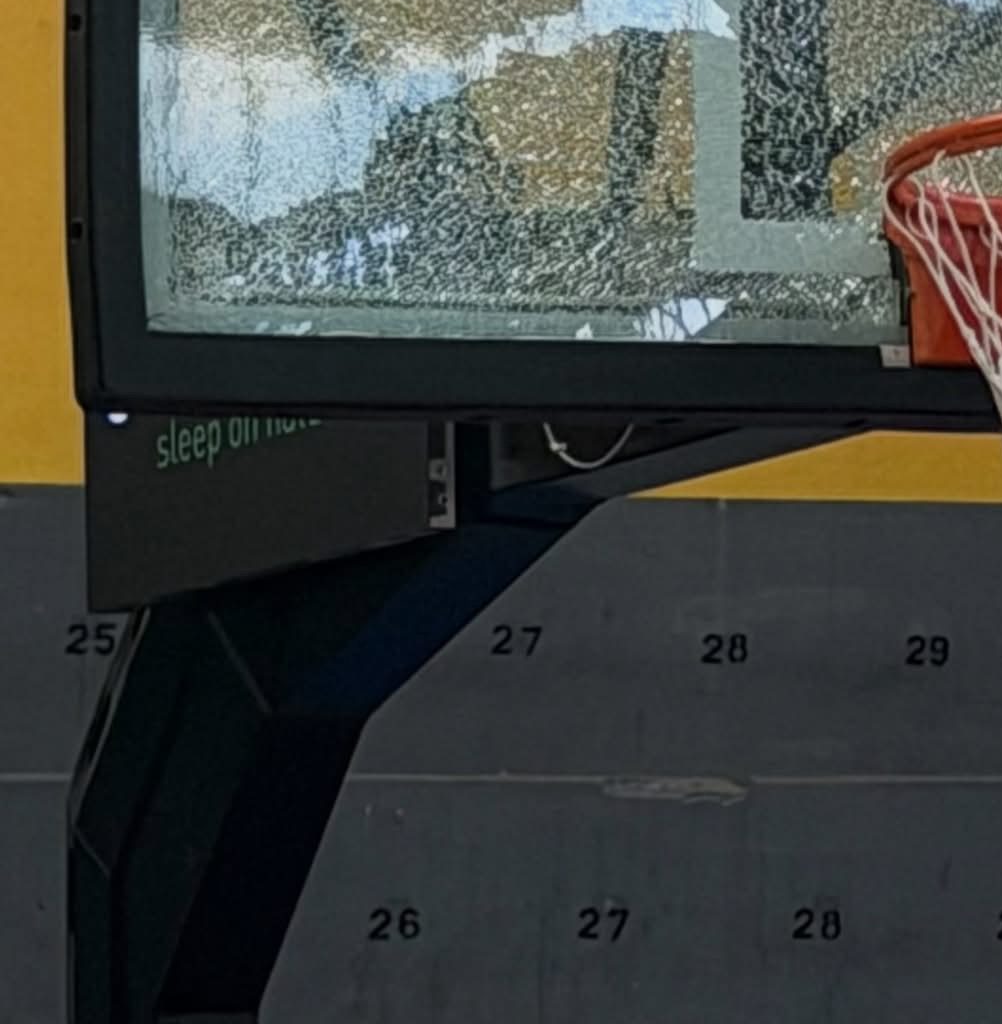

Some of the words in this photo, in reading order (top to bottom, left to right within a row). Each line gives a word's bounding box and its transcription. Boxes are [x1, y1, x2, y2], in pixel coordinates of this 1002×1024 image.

[157, 419, 221, 469] sleep
[65, 623, 115, 656] 25
[491, 624, 542, 657] 27
[701, 634, 748, 665] 28
[905, 635, 950, 666] 29
[368, 907, 420, 941] 26
[578, 907, 630, 942] 27
[792, 908, 842, 941] 28
